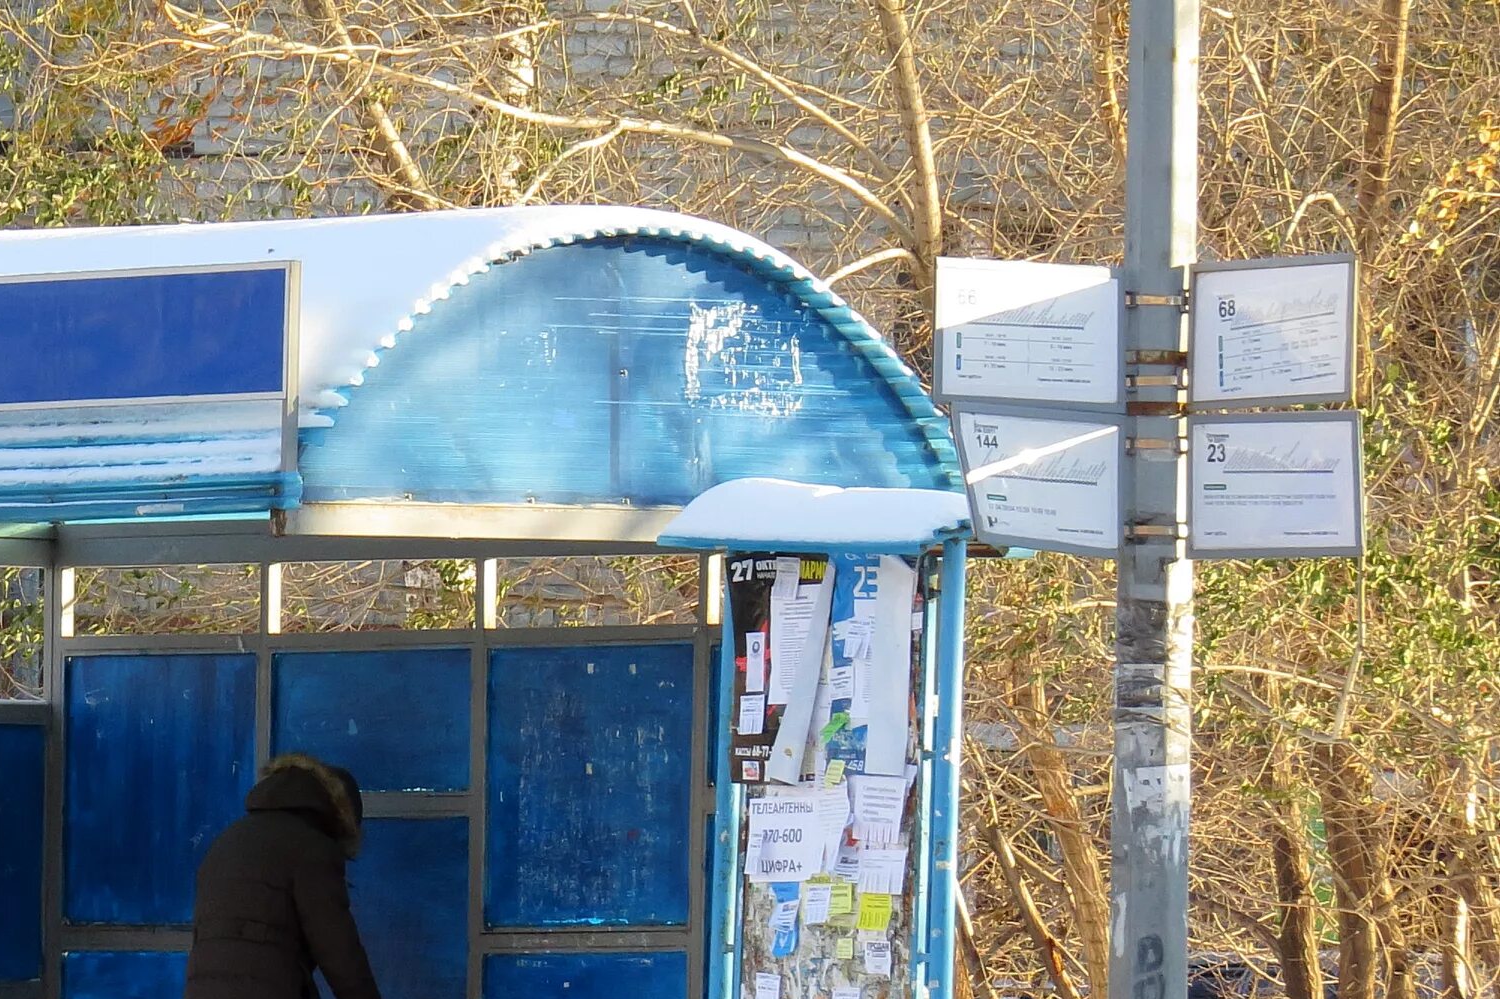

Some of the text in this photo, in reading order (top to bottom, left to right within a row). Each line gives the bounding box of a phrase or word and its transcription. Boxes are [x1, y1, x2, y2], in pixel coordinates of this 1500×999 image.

[1218, 300, 1236, 317] 68
[976, 434, 998, 448] 144
[1207, 443, 1226, 462] 23
[731, 558, 753, 582] 27
[752, 801, 814, 815] ТЕЛЕАНТЕННЫ
[761, 859, 803, 875] ЦИФРА+
